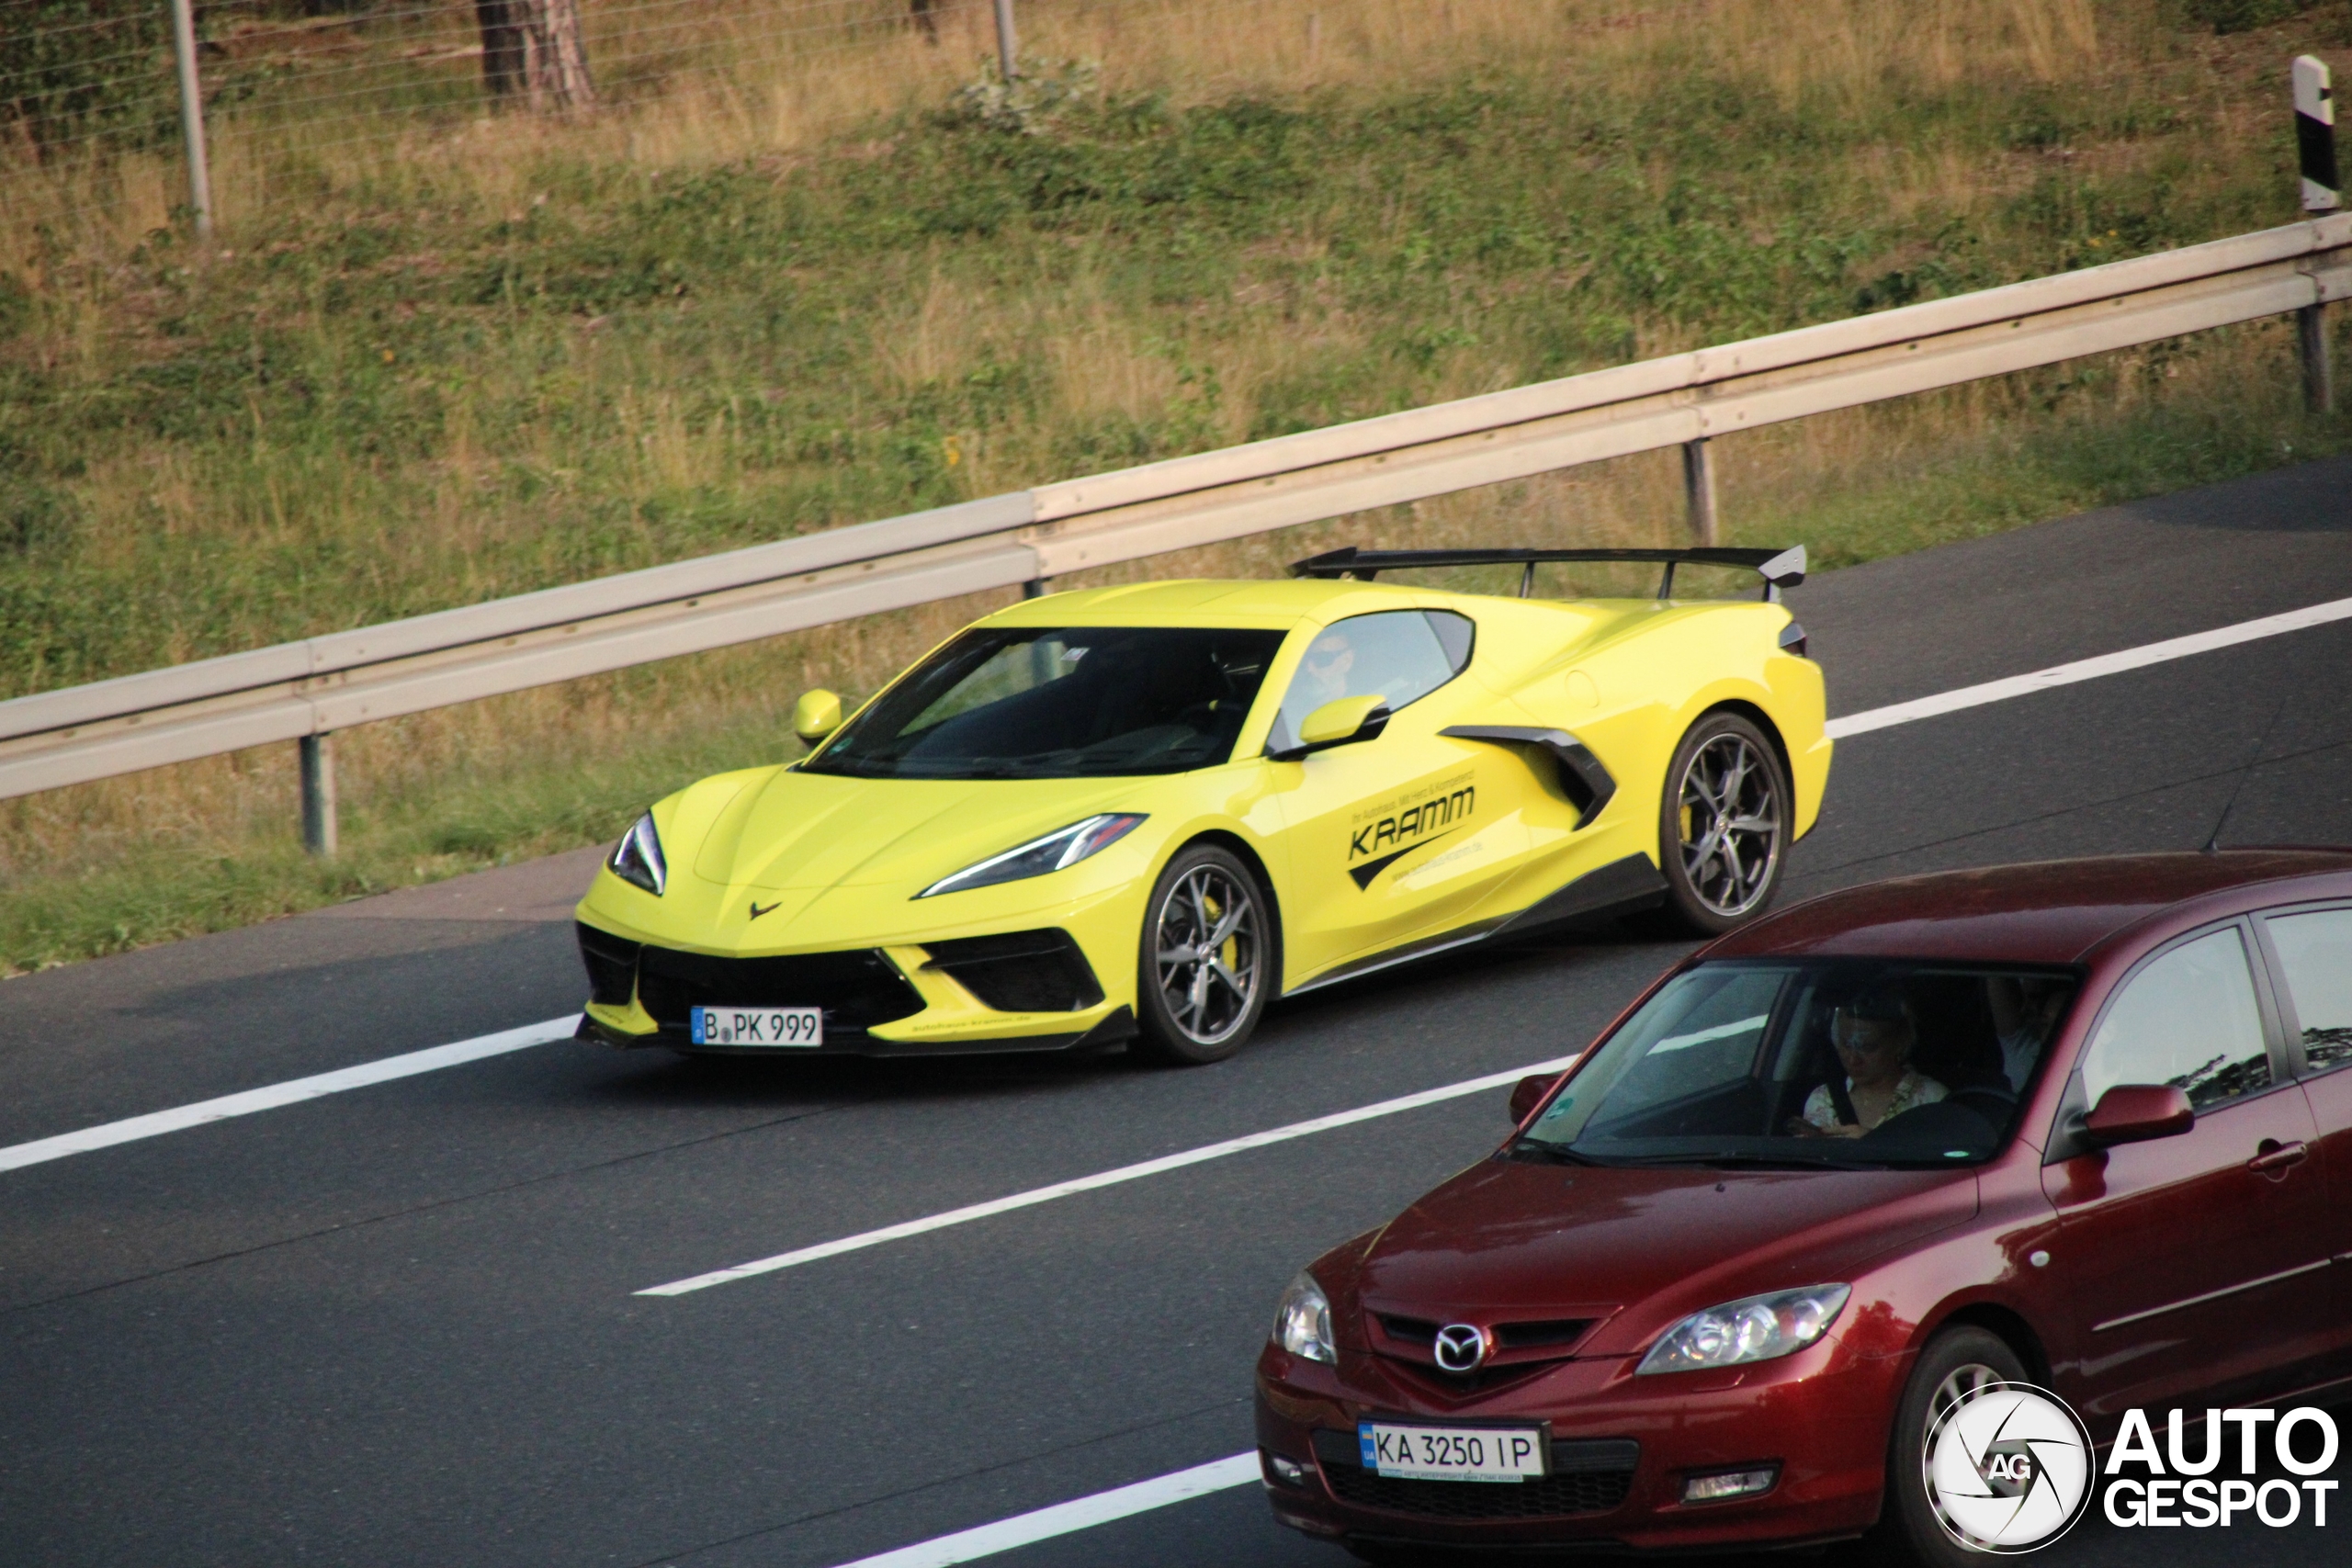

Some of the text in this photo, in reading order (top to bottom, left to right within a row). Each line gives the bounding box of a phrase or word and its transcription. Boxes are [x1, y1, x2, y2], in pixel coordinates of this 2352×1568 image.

[705, 1012, 817, 1041] B PK 999
[1364, 1450, 1375, 1460] UA
[1376, 1432, 1415, 1464] KA
[1420, 1436, 1484, 1467] 3250
